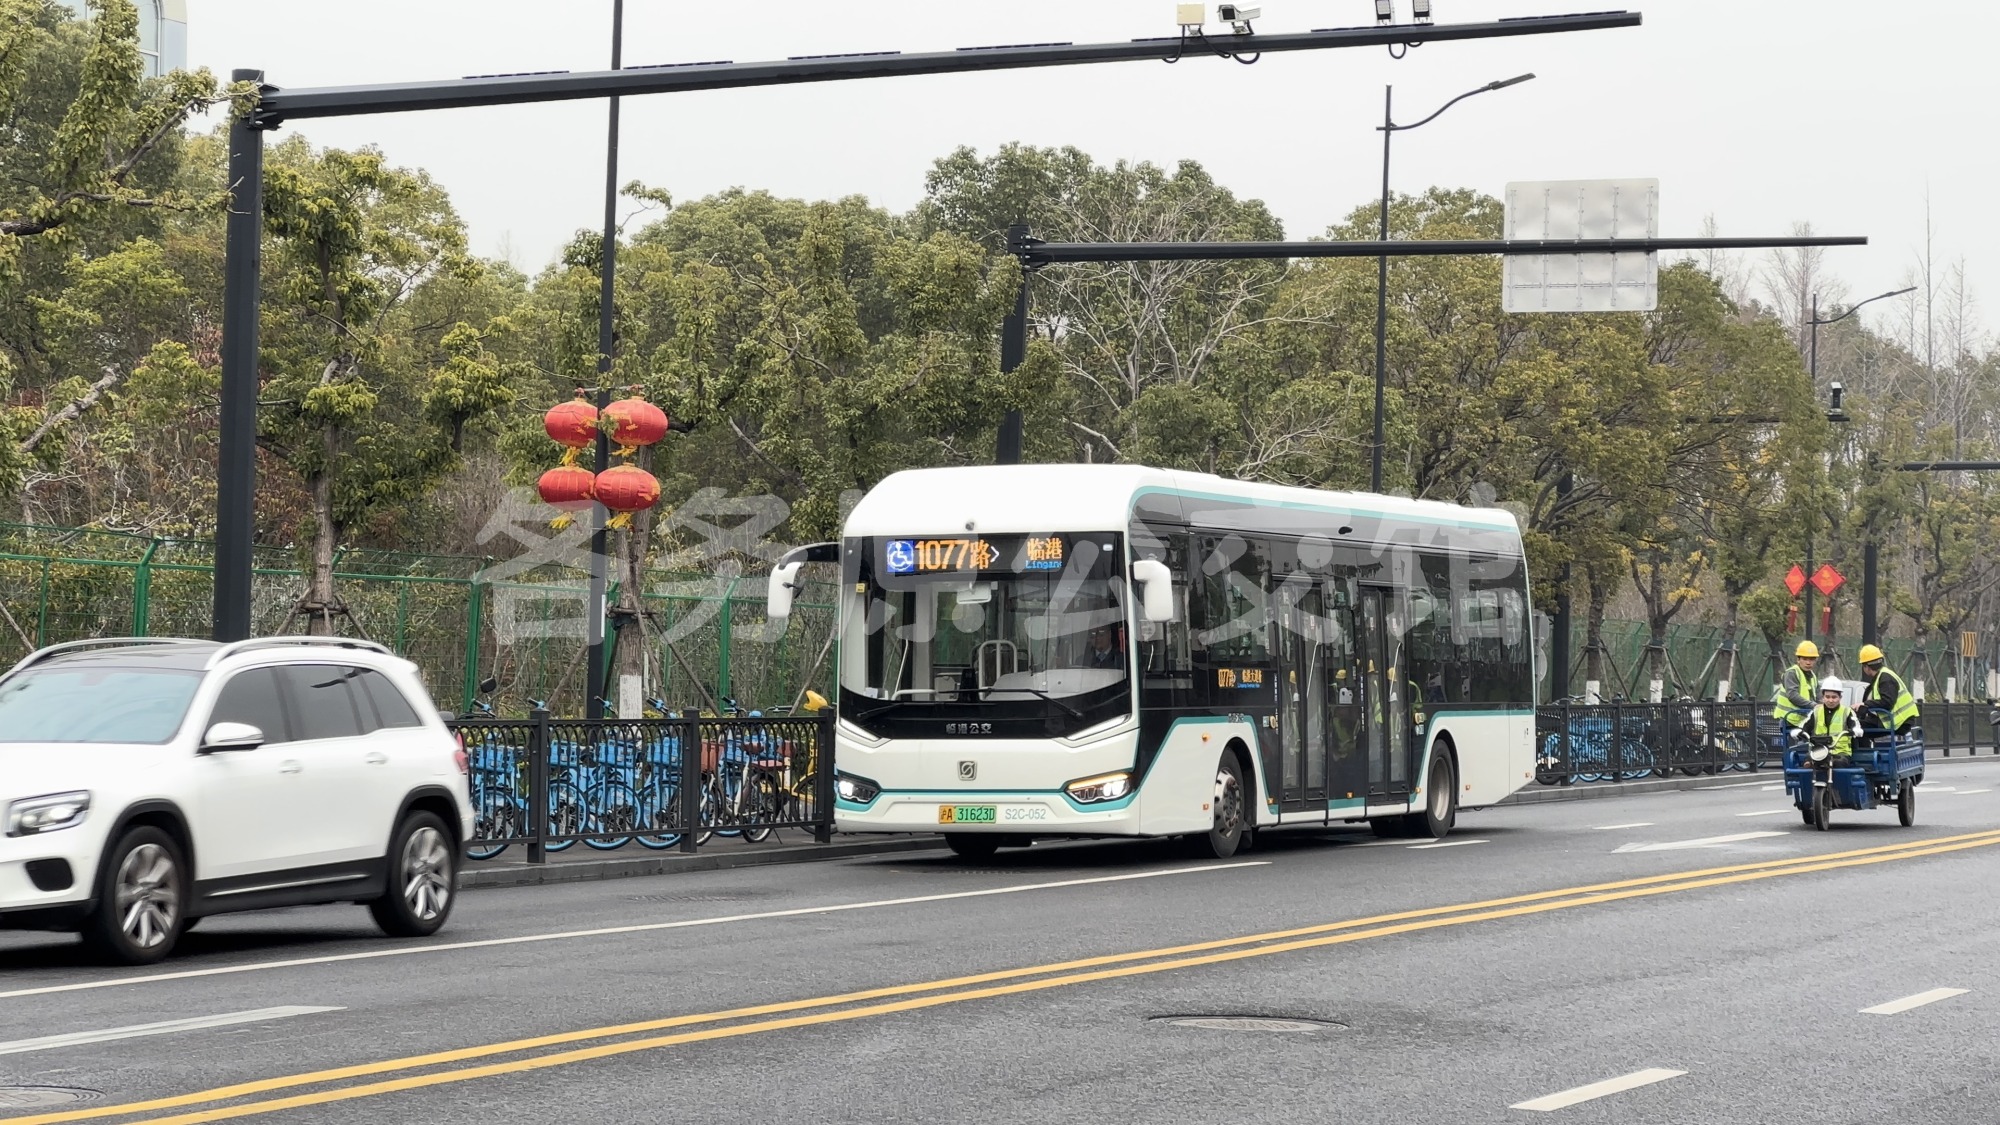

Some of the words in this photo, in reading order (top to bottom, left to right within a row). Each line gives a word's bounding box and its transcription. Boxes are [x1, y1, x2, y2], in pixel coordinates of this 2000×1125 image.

[914, 539, 991, 570] 1077路
[1027, 537, 1063, 561] 临港
[946, 723, 992, 734] 临港公交
[1005, 808, 1047, 820] S2C-052
